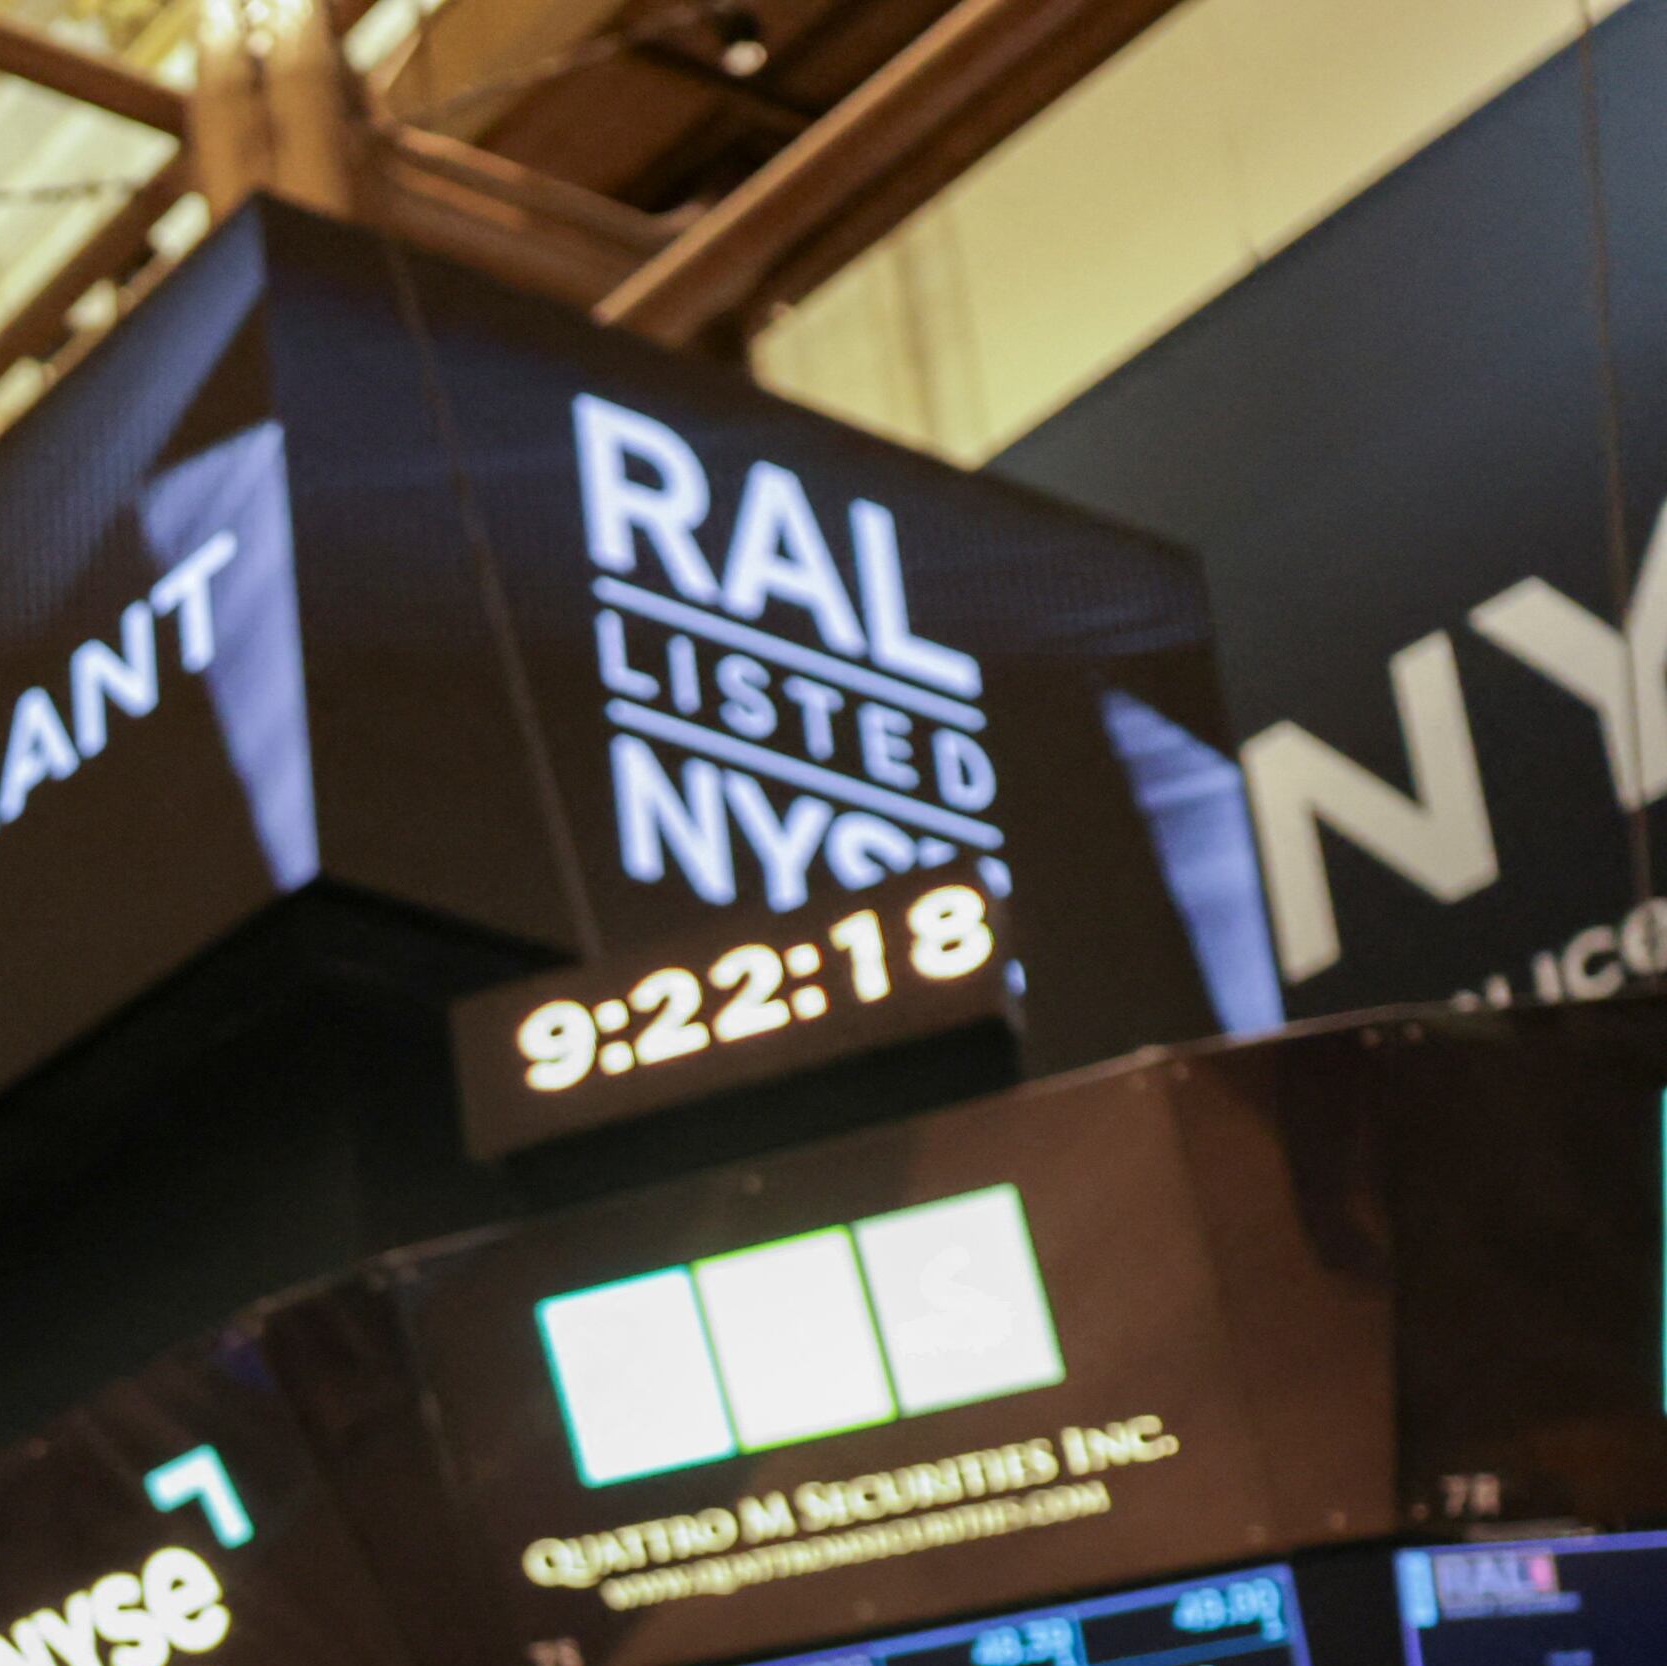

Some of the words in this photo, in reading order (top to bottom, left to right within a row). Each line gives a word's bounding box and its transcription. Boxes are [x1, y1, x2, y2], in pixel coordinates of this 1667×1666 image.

[572, 391, 984, 699] RAL
[593, 608, 997, 813] LISTED
[609, 732, 1012, 913] NYS
[517, 883, 995, 1093] 9:22:18
